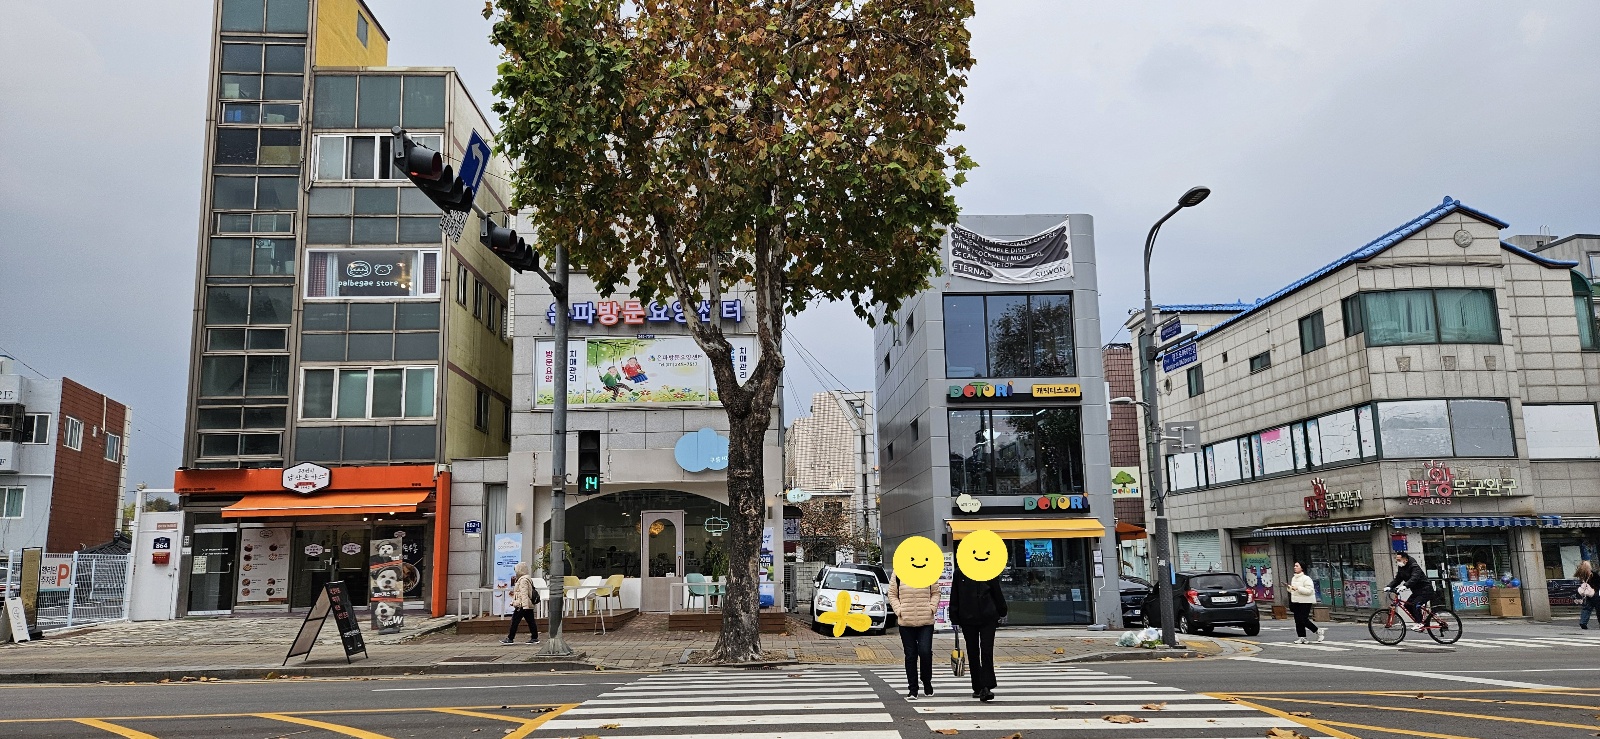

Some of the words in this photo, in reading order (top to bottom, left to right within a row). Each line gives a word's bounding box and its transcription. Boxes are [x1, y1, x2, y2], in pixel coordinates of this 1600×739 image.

[953, 263, 991, 277] ETERNAL
[1035, 265, 1066, 277] SUWON
[569, 350, 577, 383] 치매관리
[739, 346, 747, 379] 치매관리
[585, 476, 598, 490] 14
[1407, 497, 1452, 505] 242-4435
[57, 563, 70, 587] P
